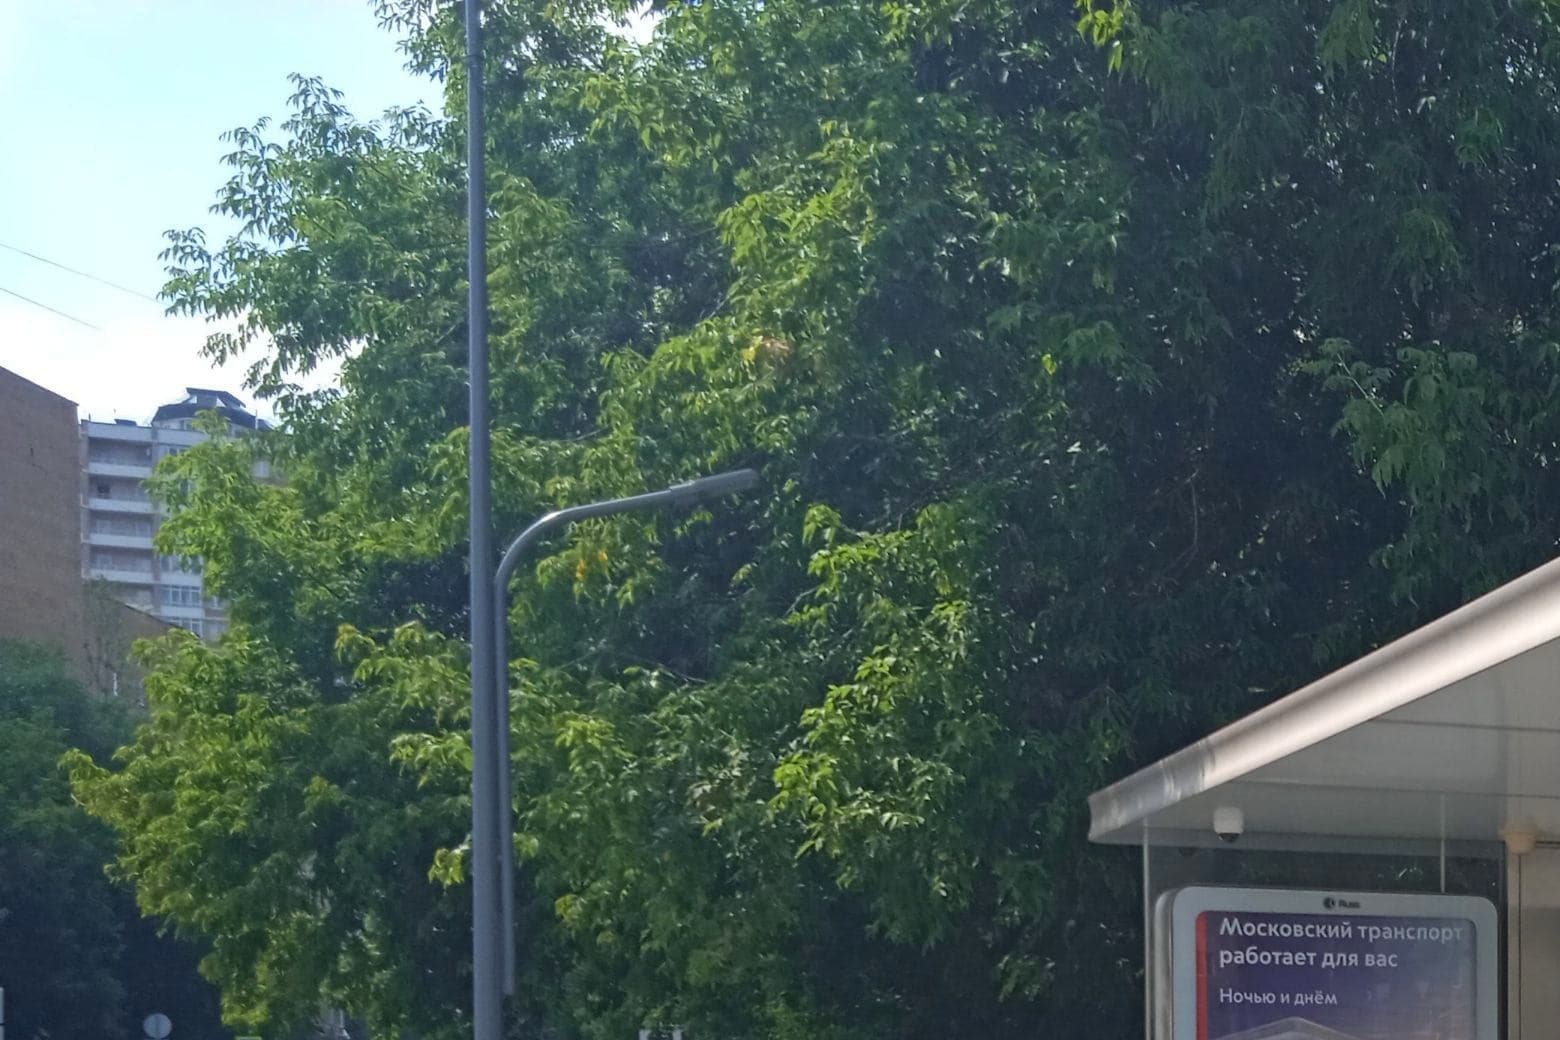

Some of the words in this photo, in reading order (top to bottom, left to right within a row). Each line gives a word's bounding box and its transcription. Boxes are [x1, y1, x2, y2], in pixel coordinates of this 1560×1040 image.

[1219, 916, 1352, 939] Московский
[1357, 925, 1463, 943] транспорт
[1219, 946, 1317, 968] работает
[1321, 952, 1359, 968] для
[1364, 953, 1398, 968] вас
[1219, 987, 1275, 1005] Ночью
[1280, 993, 1290, 1005] и
[1294, 989, 1338, 1006] днём
